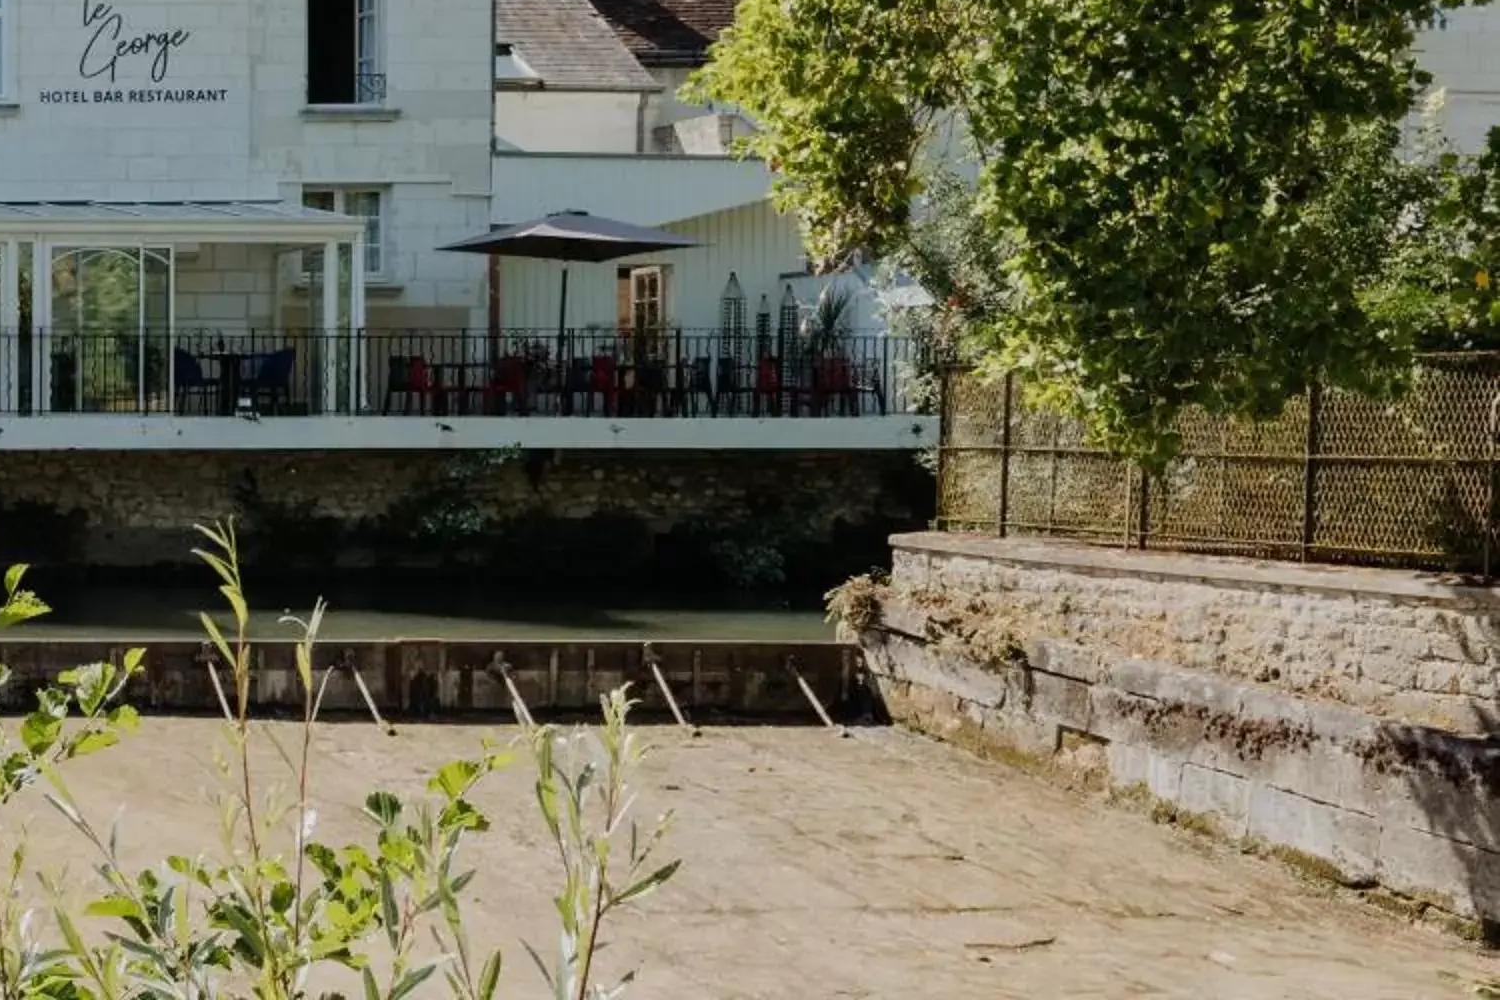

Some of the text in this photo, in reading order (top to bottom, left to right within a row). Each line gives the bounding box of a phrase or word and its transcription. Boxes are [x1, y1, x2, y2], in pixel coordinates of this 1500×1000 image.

[79, 13, 190, 84] George
[39, 89, 228, 103] HOTEL BAR RESTAURANT
